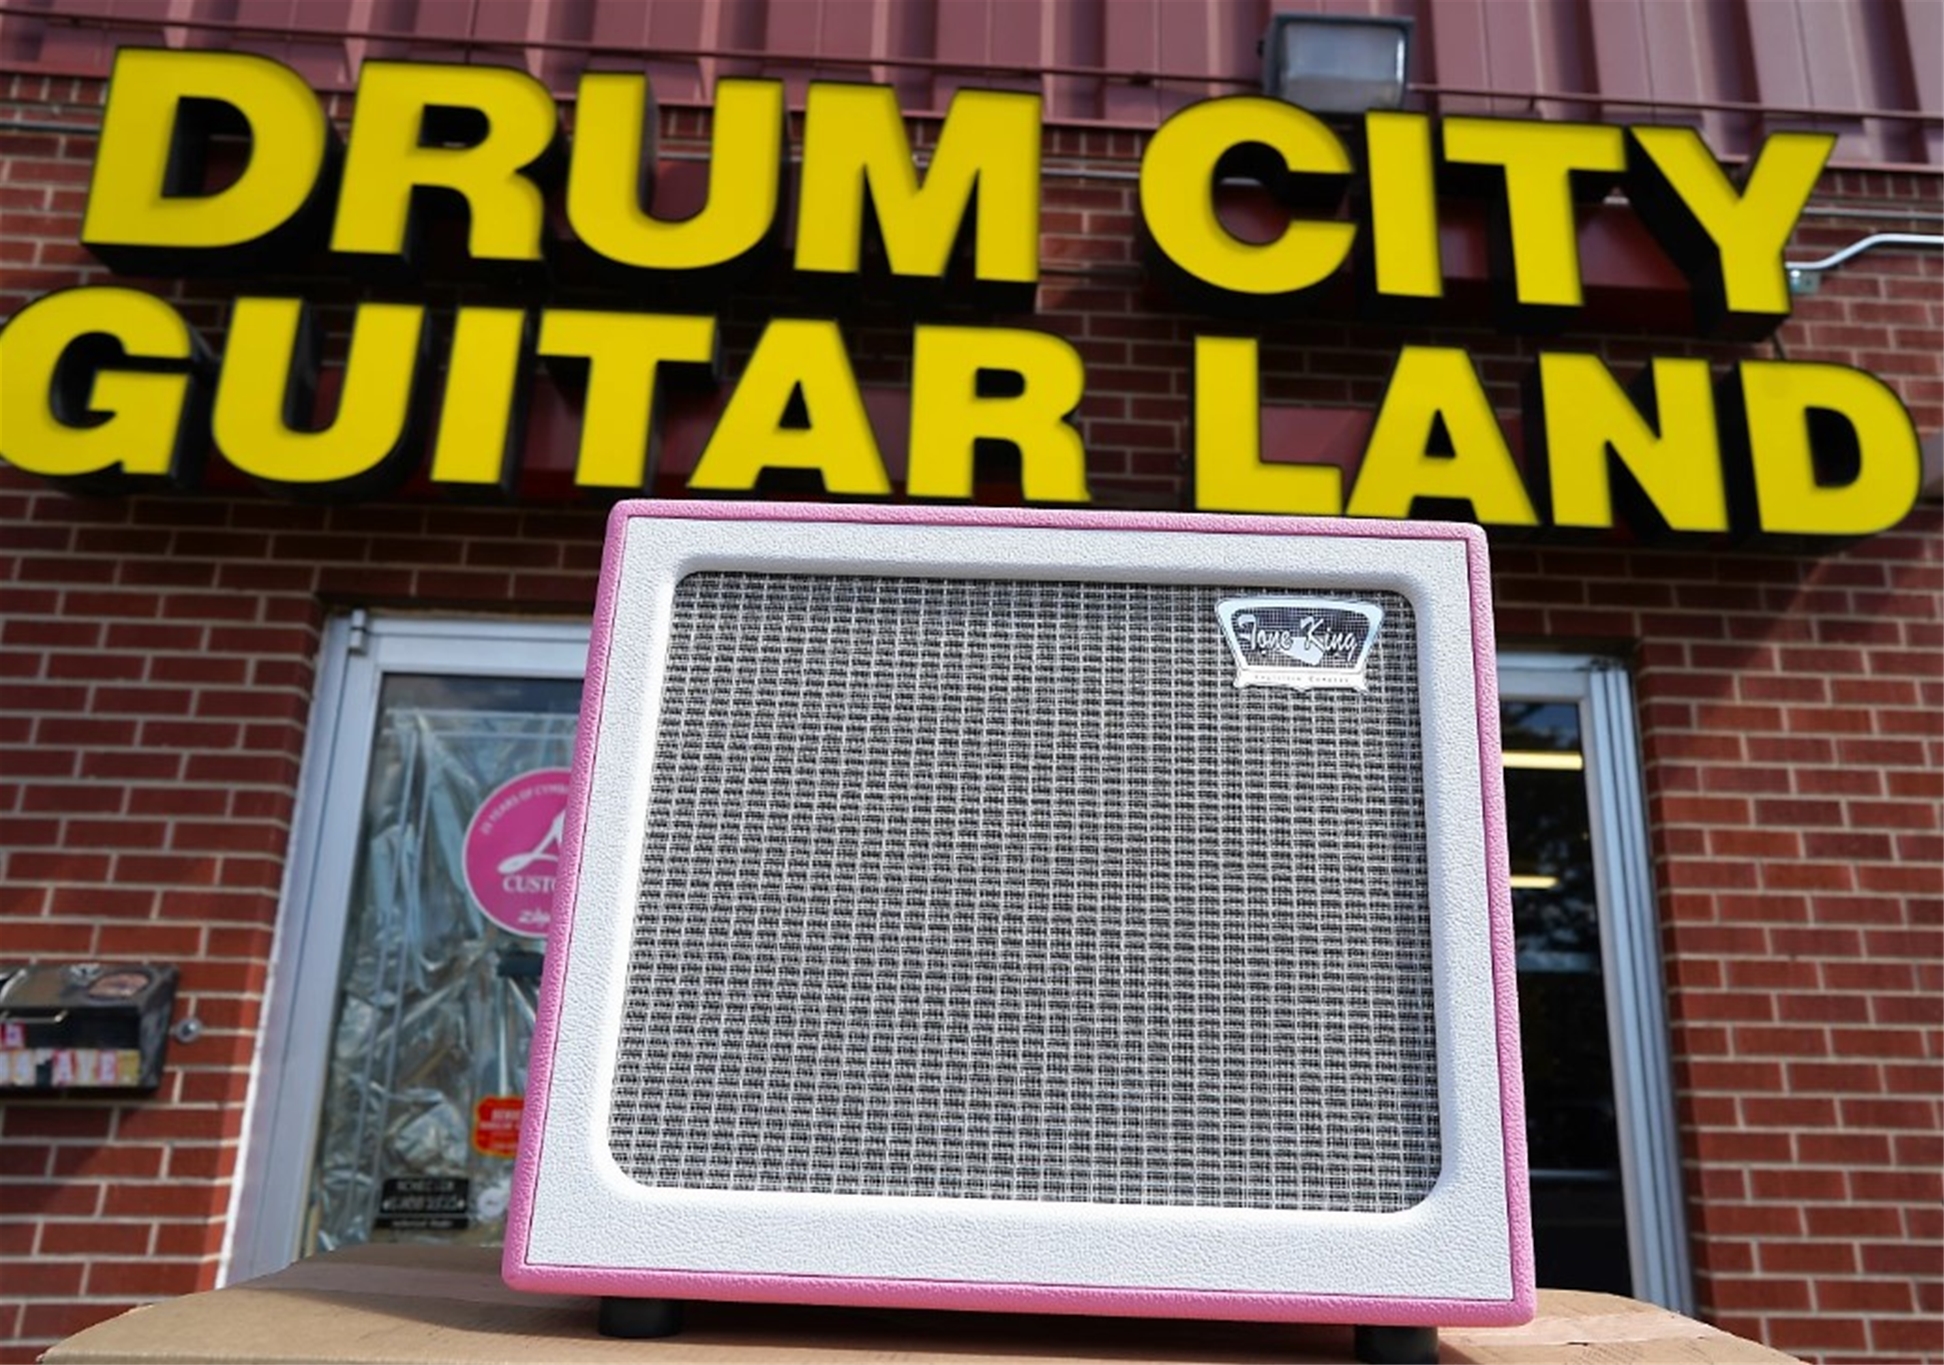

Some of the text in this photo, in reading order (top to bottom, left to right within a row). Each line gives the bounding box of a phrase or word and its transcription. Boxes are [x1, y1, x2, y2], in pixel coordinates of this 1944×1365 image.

[81, 47, 1837, 314] DRUM CITY
[0, 286, 1922, 535] GUITAR LAND
[1237, 613, 1358, 662] Tone King
